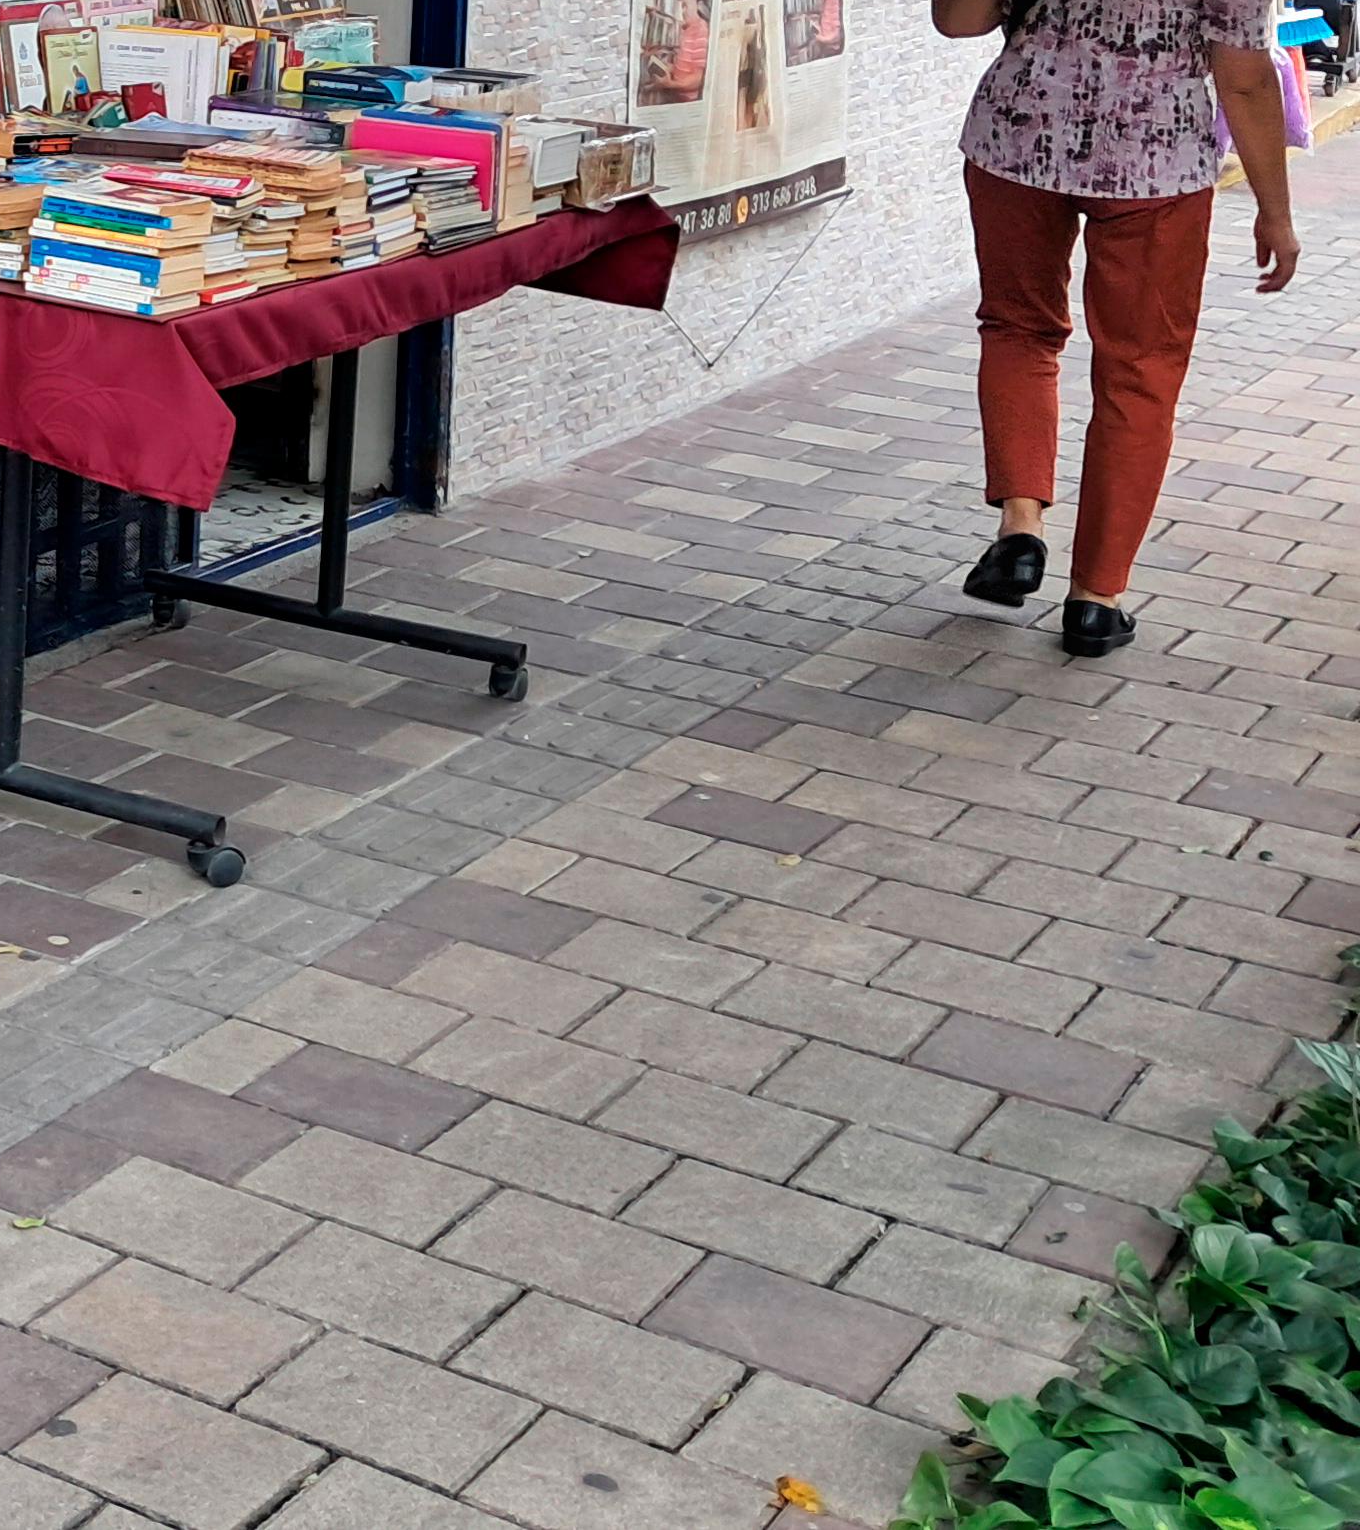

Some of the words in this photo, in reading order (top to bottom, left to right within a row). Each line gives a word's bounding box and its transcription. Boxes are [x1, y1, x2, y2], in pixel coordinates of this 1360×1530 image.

[751, 190, 769, 215] 313
[700, 207, 715, 230] 38
[718, 203, 731, 227] 80
